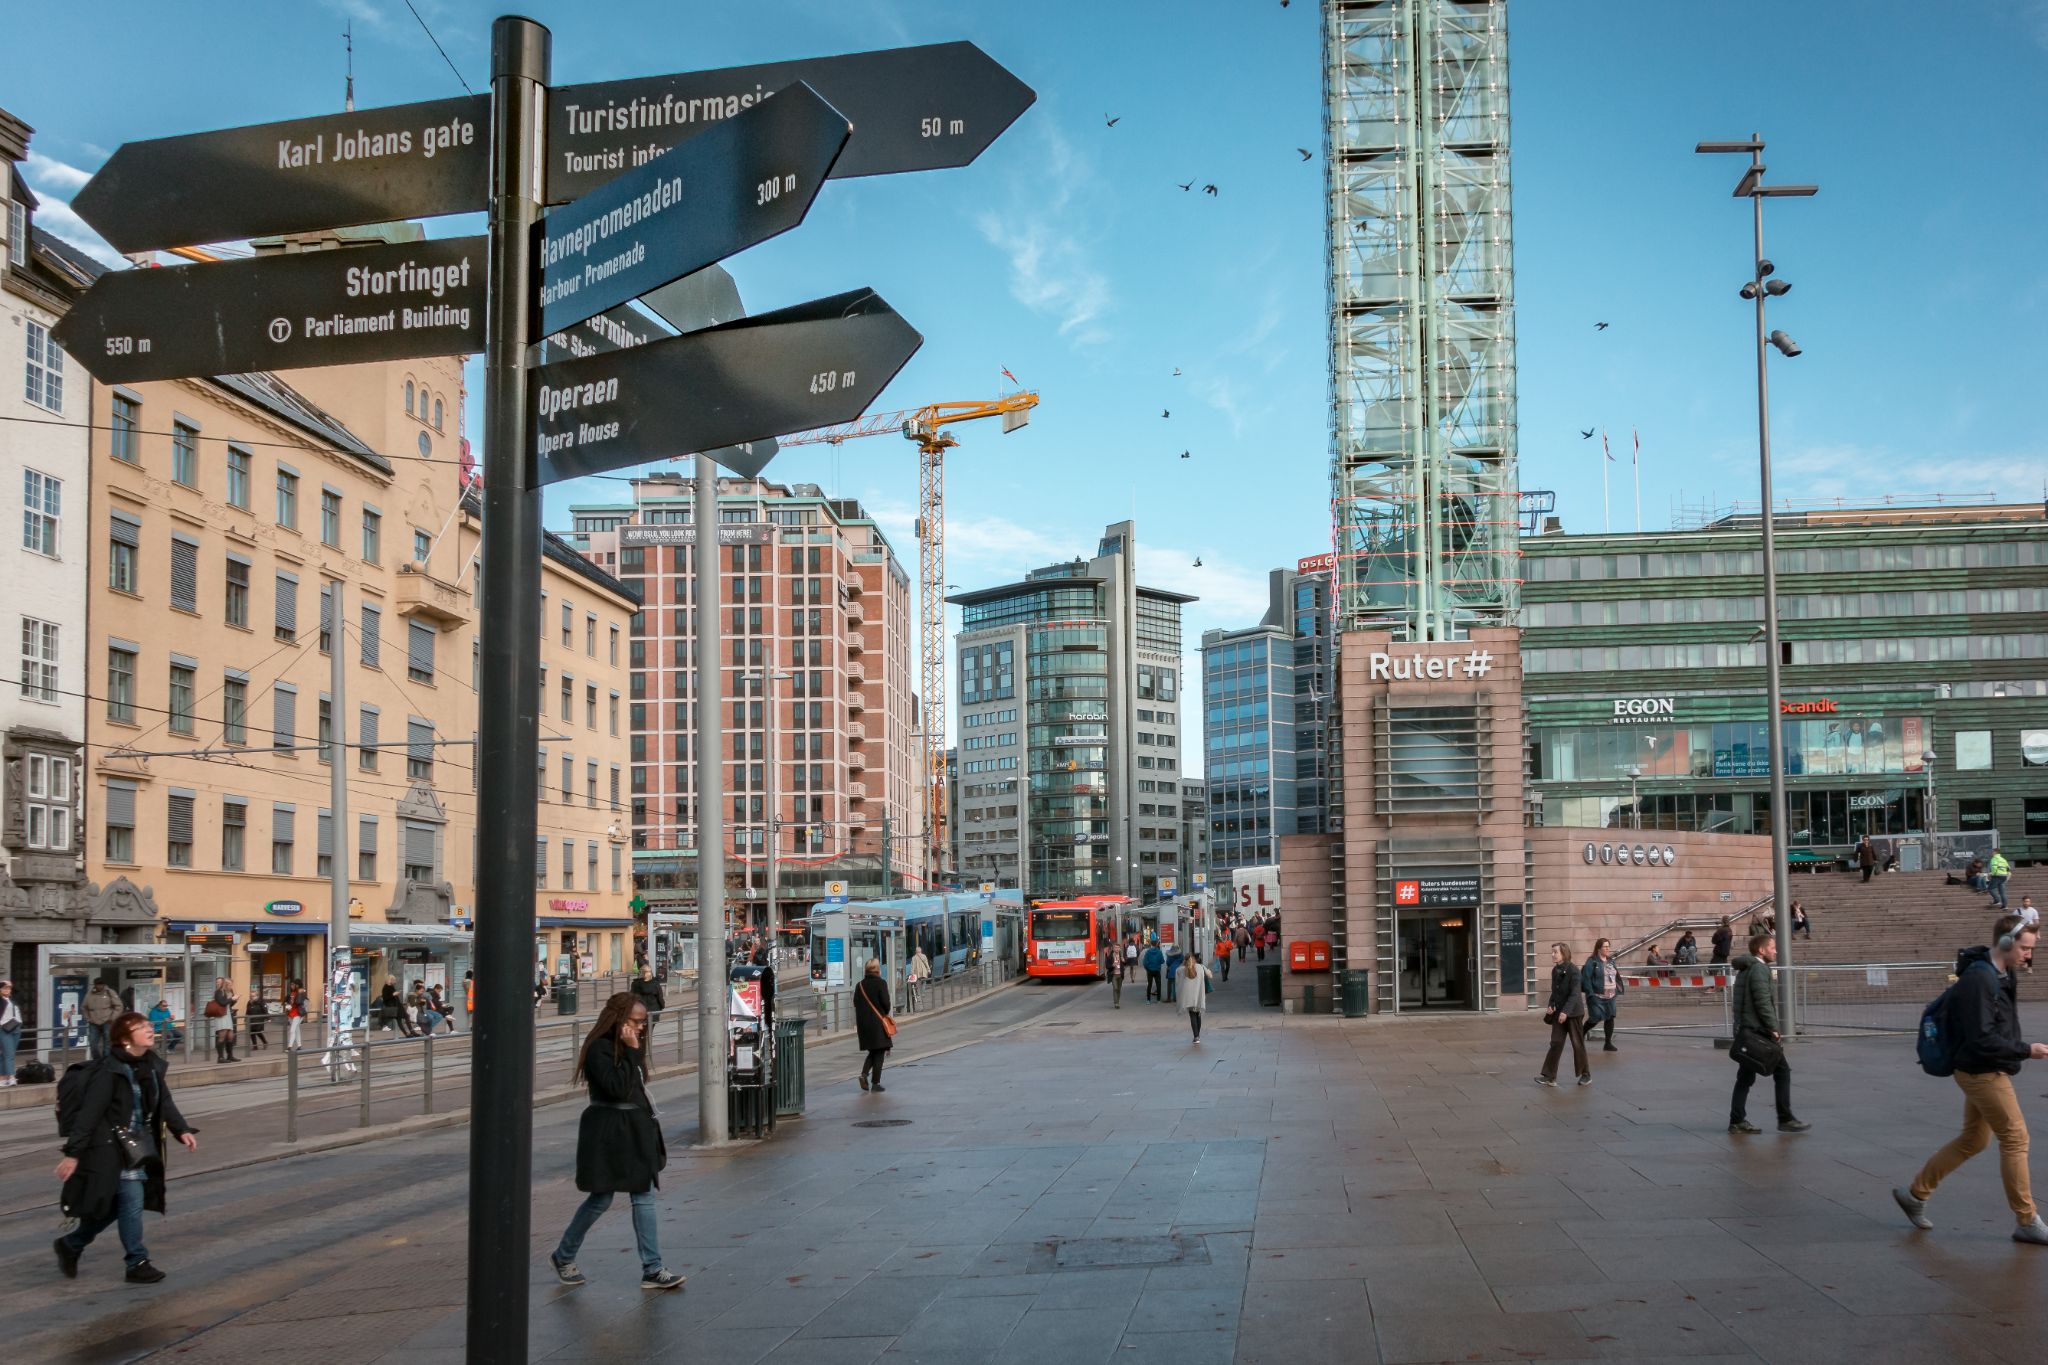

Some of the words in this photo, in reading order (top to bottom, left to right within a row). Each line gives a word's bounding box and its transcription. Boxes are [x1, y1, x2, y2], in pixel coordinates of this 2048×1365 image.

[921, 117, 942, 138] 50
[950, 118, 964, 135] m
[278, 134, 323, 169] Karl
[332, 129, 412, 162] Johans
[423, 117, 475, 158] gate
[564, 147, 625, 173] Tourist
[757, 176, 780, 206] 300
[785, 173, 796, 193] m
[540, 176, 682, 269] Havnepromenaden
[346, 256, 470, 297] Stortinget
[540, 274, 582, 308] Harbour
[585, 241, 645, 287] Promenade
[305, 309, 396, 338] Parliament
[402, 304, 470, 330] Building
[106, 336, 132, 356] 550
[138, 338, 151, 353] m
[809, 370, 837, 394] 450
[842, 370, 856, 388] m
[539, 377, 619, 422] Operaen
[537, 431, 574, 459] Opera
[578, 421, 620, 445] House
[1613, 716, 1675, 724] RESTAURANT
[1614, 698, 1674, 715] EGON
[1780, 697, 1838, 714] Scandic
[1850, 795, 1885, 806] EGON
